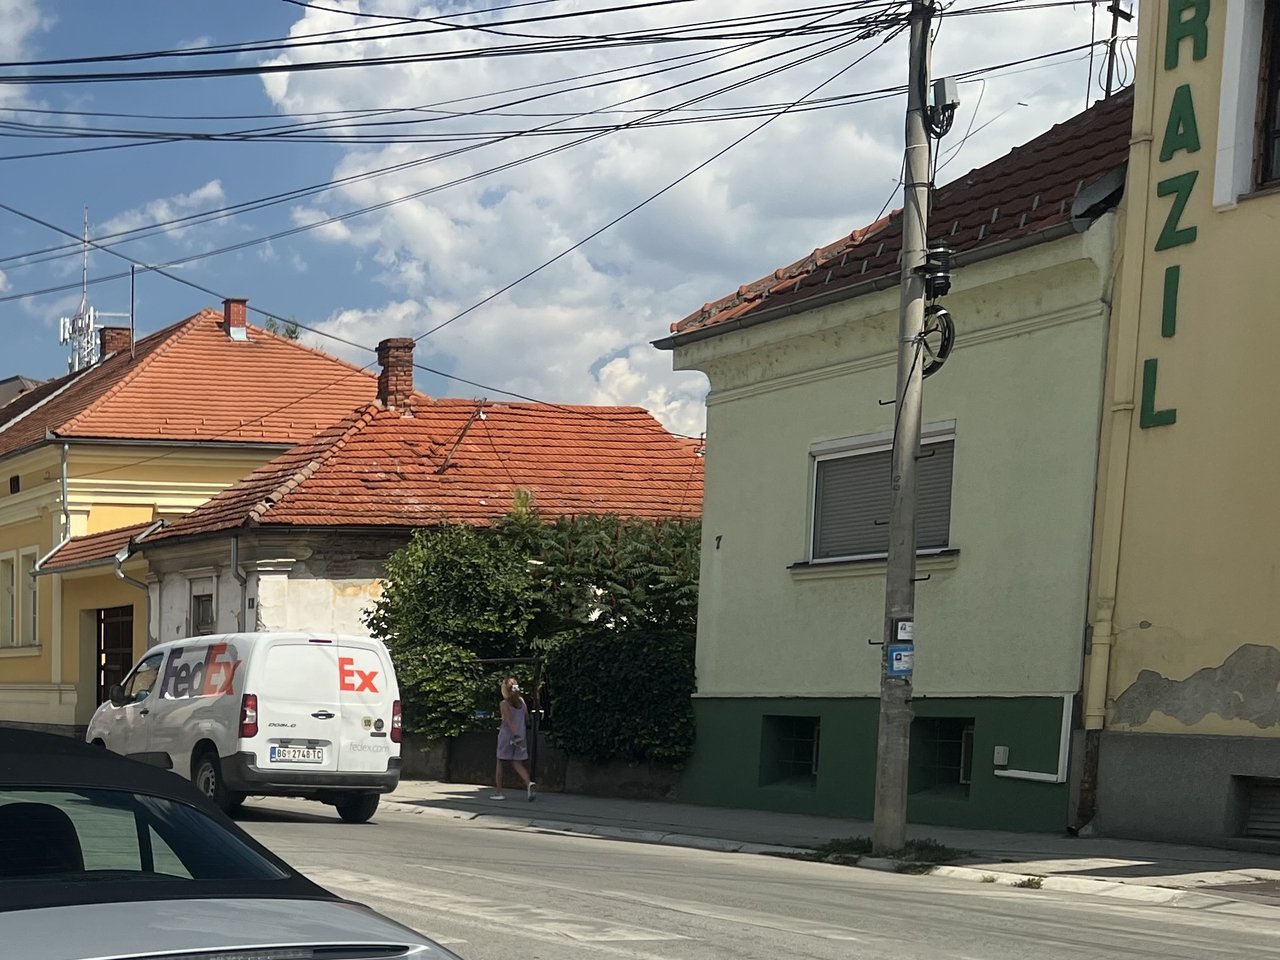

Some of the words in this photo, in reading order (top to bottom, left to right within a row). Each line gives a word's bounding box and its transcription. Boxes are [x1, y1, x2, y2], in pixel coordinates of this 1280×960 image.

[715, 535, 723, 550] 7
[159, 642, 242, 699] FedEx
[338, 657, 380, 693] Ex
[349, 741, 390, 753] fedex.com
